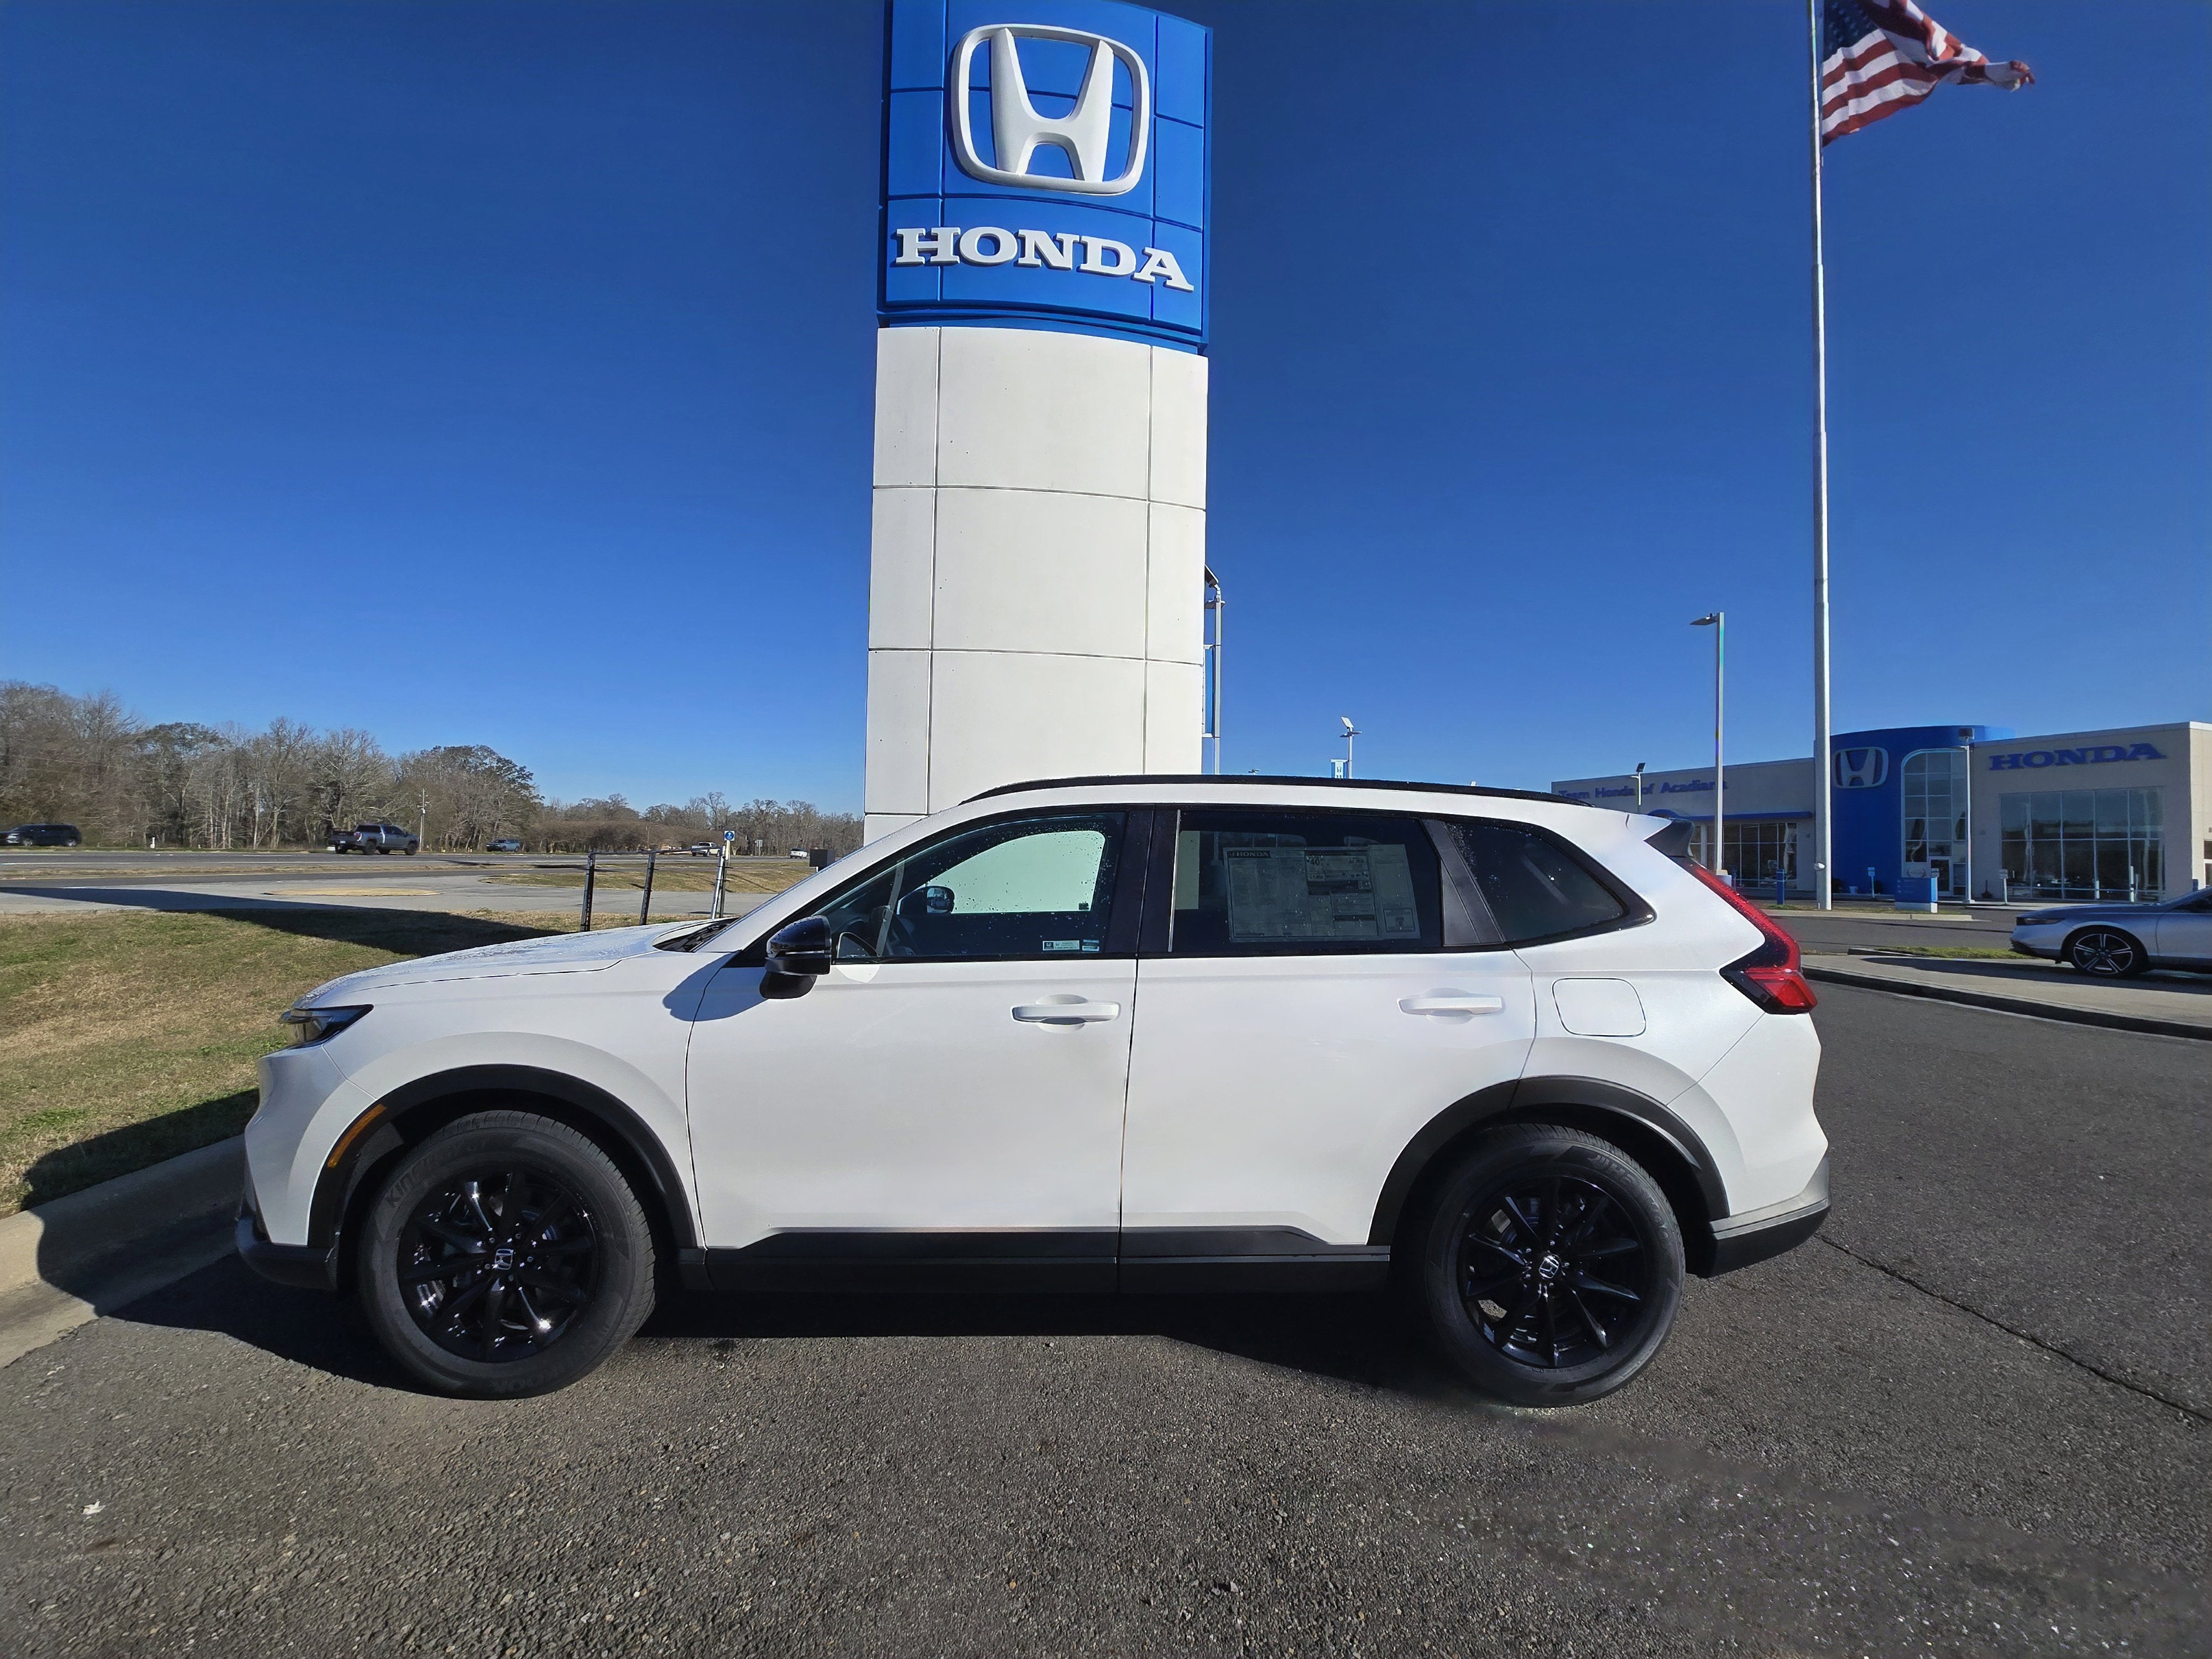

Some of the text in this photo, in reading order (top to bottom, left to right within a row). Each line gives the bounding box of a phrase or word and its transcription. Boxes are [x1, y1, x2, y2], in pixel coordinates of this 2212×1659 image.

[895, 227, 1194, 293] HONDA
[1989, 743, 2167, 770] HONDA
[1558, 790, 1589, 799] Team
[1595, 785, 1636, 797] Honda
[1642, 783, 1655, 795] of
